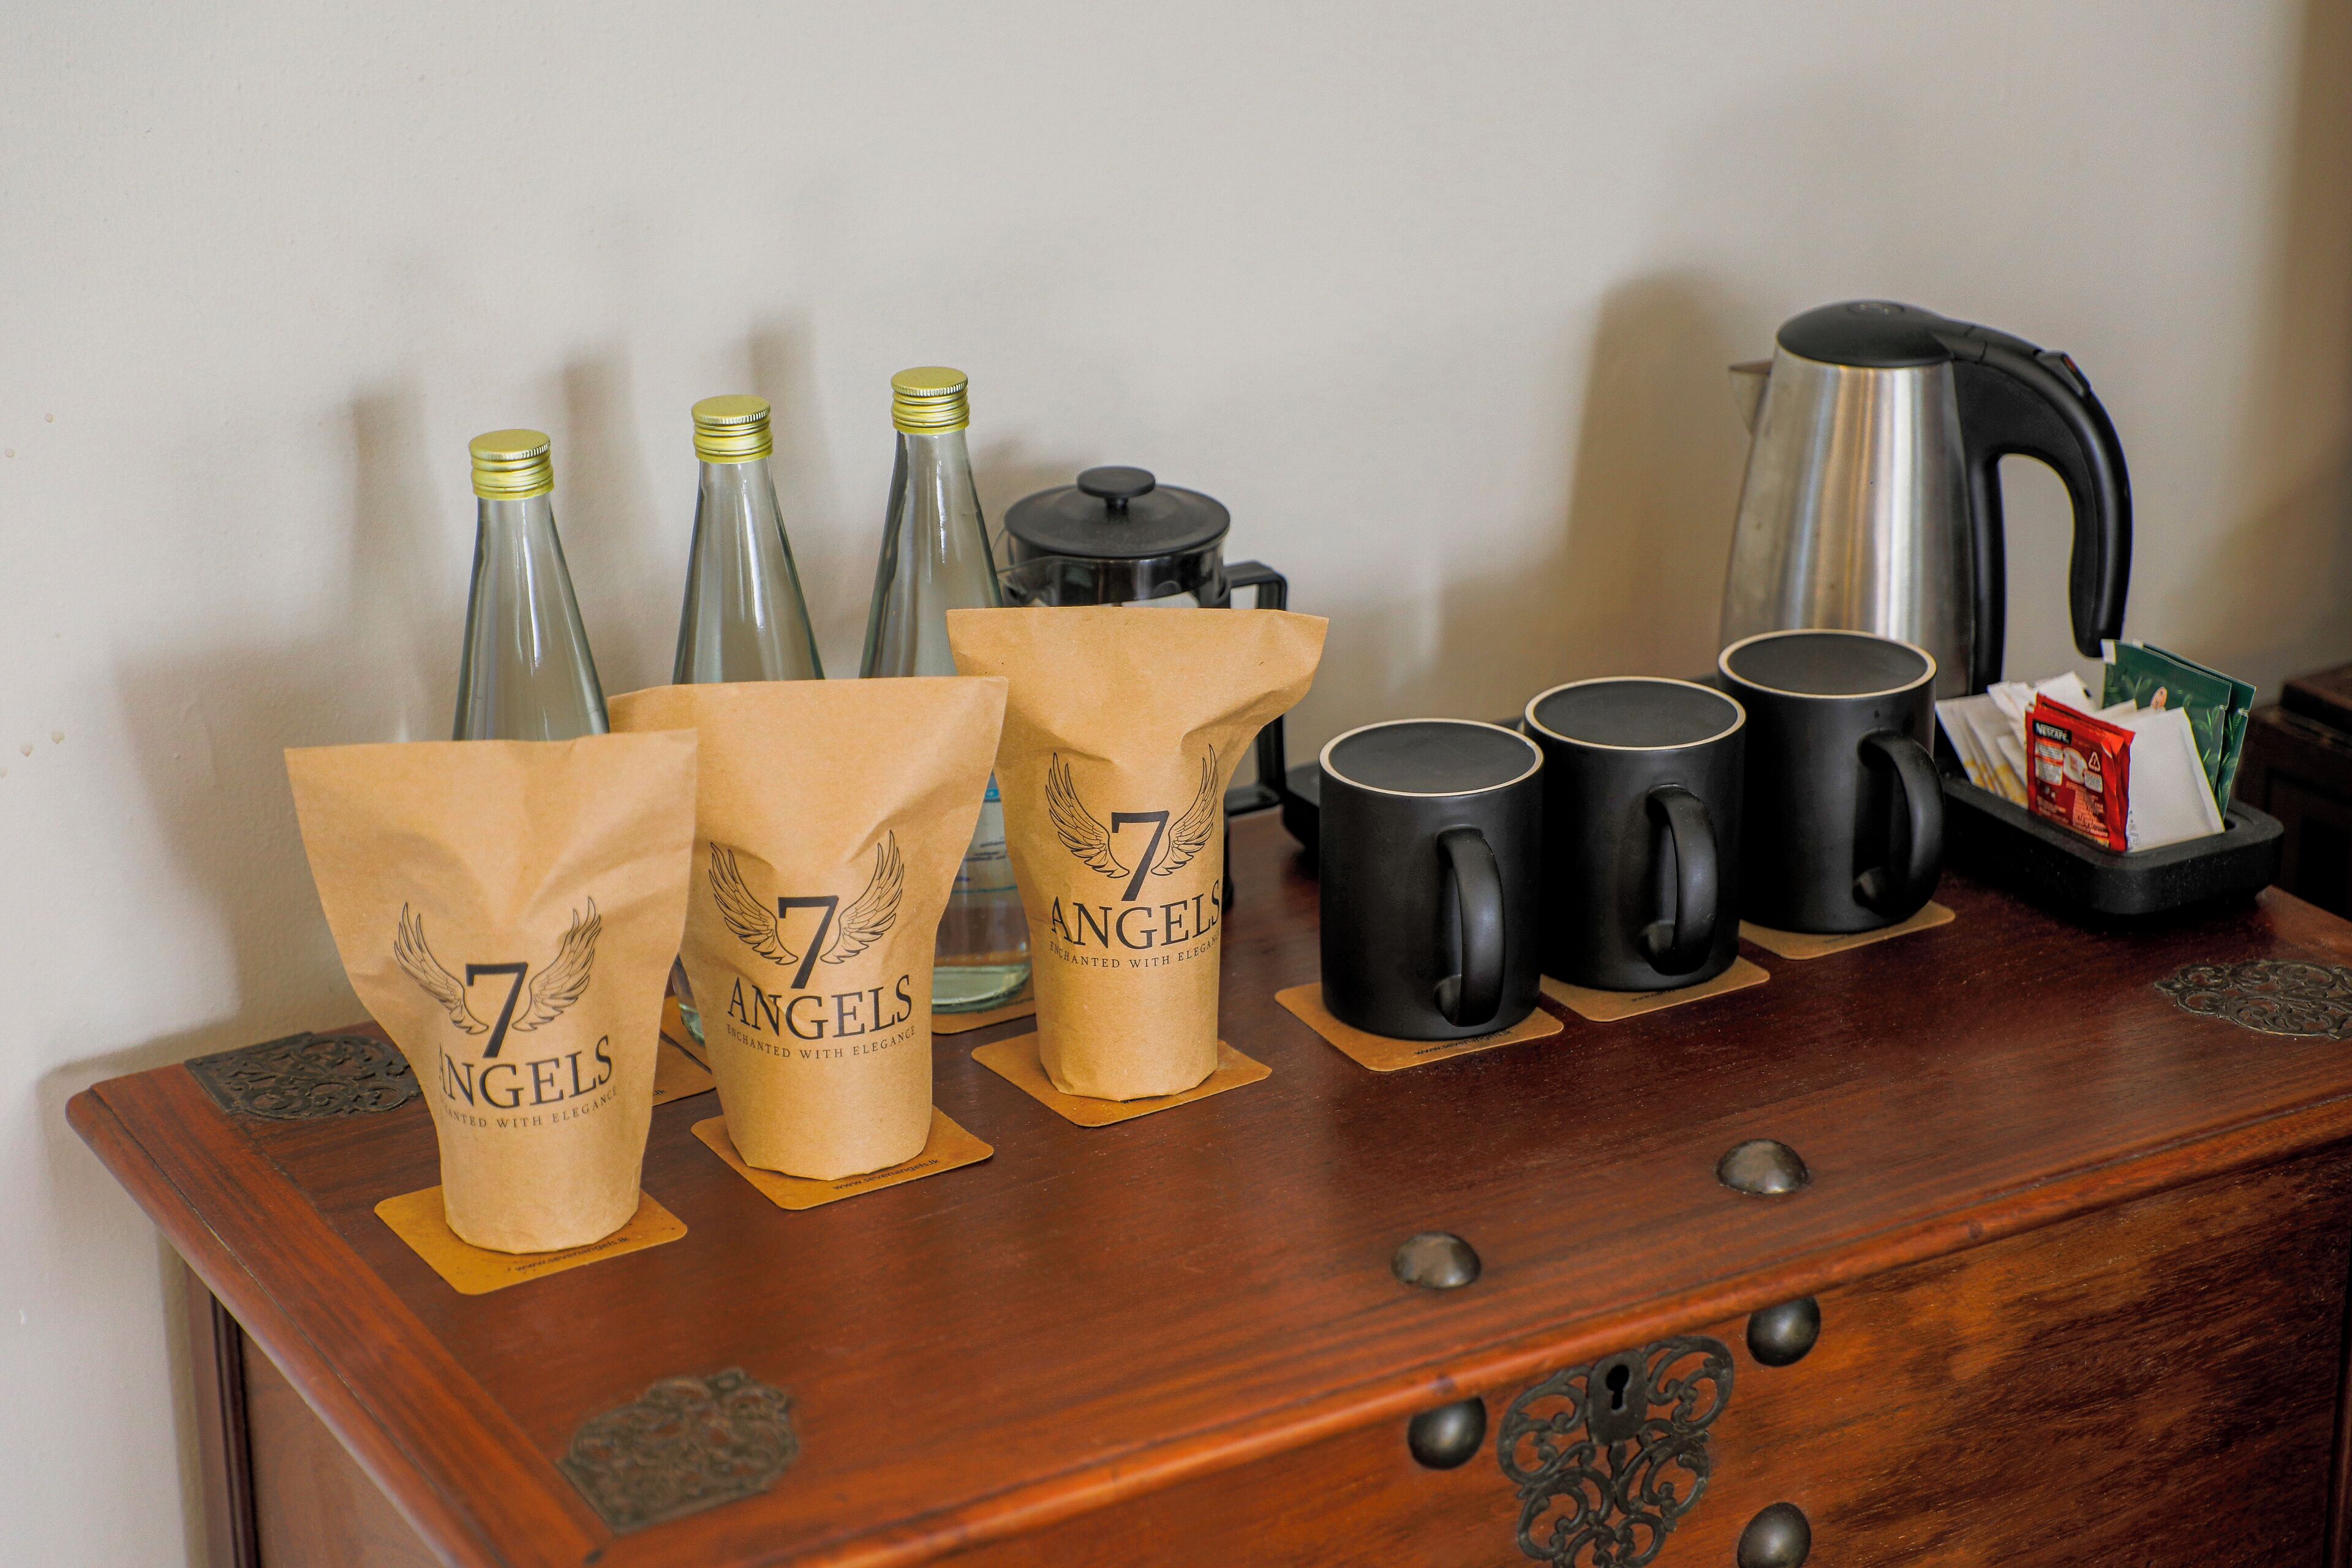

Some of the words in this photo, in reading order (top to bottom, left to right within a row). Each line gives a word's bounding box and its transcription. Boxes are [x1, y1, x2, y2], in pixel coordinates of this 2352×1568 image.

[1111, 810, 1170, 902] 7
[777, 895, 839, 990] 7
[1051, 879, 1219, 950] ANGELS
[1050, 941, 1120, 968] ENCHANTED
[1129, 955, 1170, 968] WITH
[465, 961, 529, 1059] 7
[727, 974, 913, 1040] ANGELS
[726, 1024, 791, 1058] ENCHANTED
[800, 1048, 843, 1059] WITH
[853, 1025, 916, 1056] ELEGANCE
[496, 1116, 542, 1128] WITH
[552, 1085, 617, 1123] ELEGANCE
[833, 1159, 940, 1190] www.sevenangels.lk
